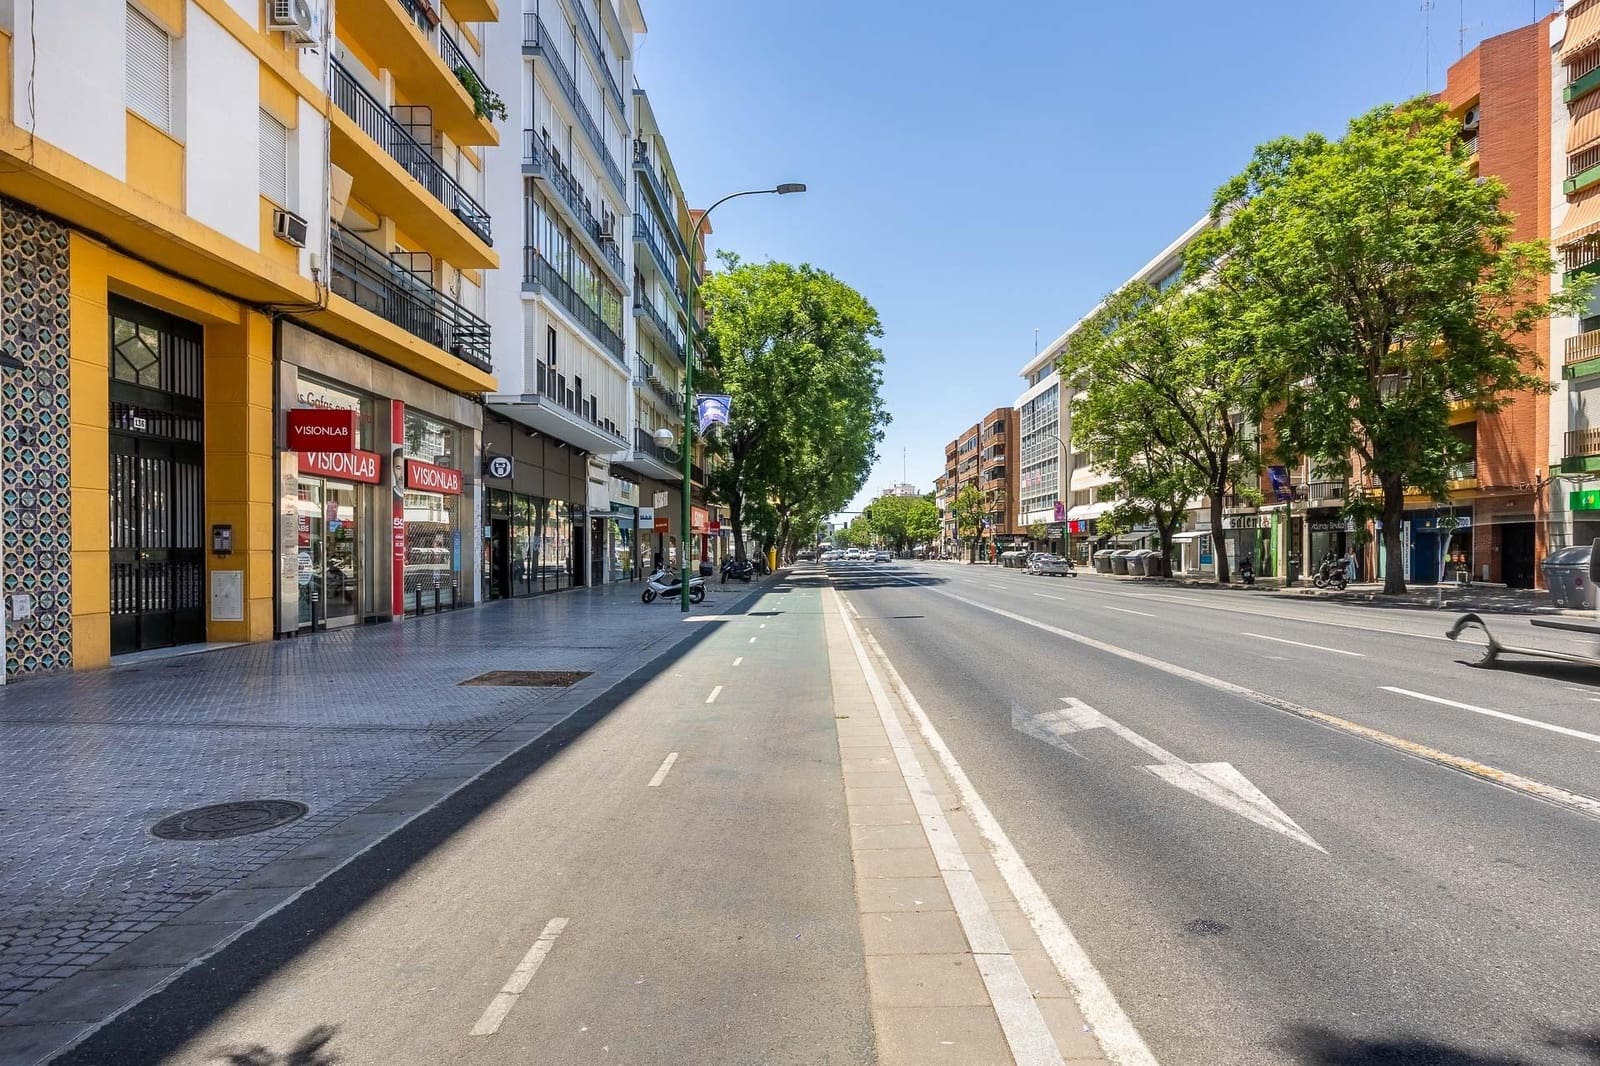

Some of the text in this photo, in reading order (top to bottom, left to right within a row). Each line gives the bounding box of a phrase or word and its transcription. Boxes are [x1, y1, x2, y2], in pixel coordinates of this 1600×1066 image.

[294, 425, 348, 436] VISIONLAB
[307, 452, 375, 478] VISIONLAB
[412, 464, 458, 490] VISIONLAB
